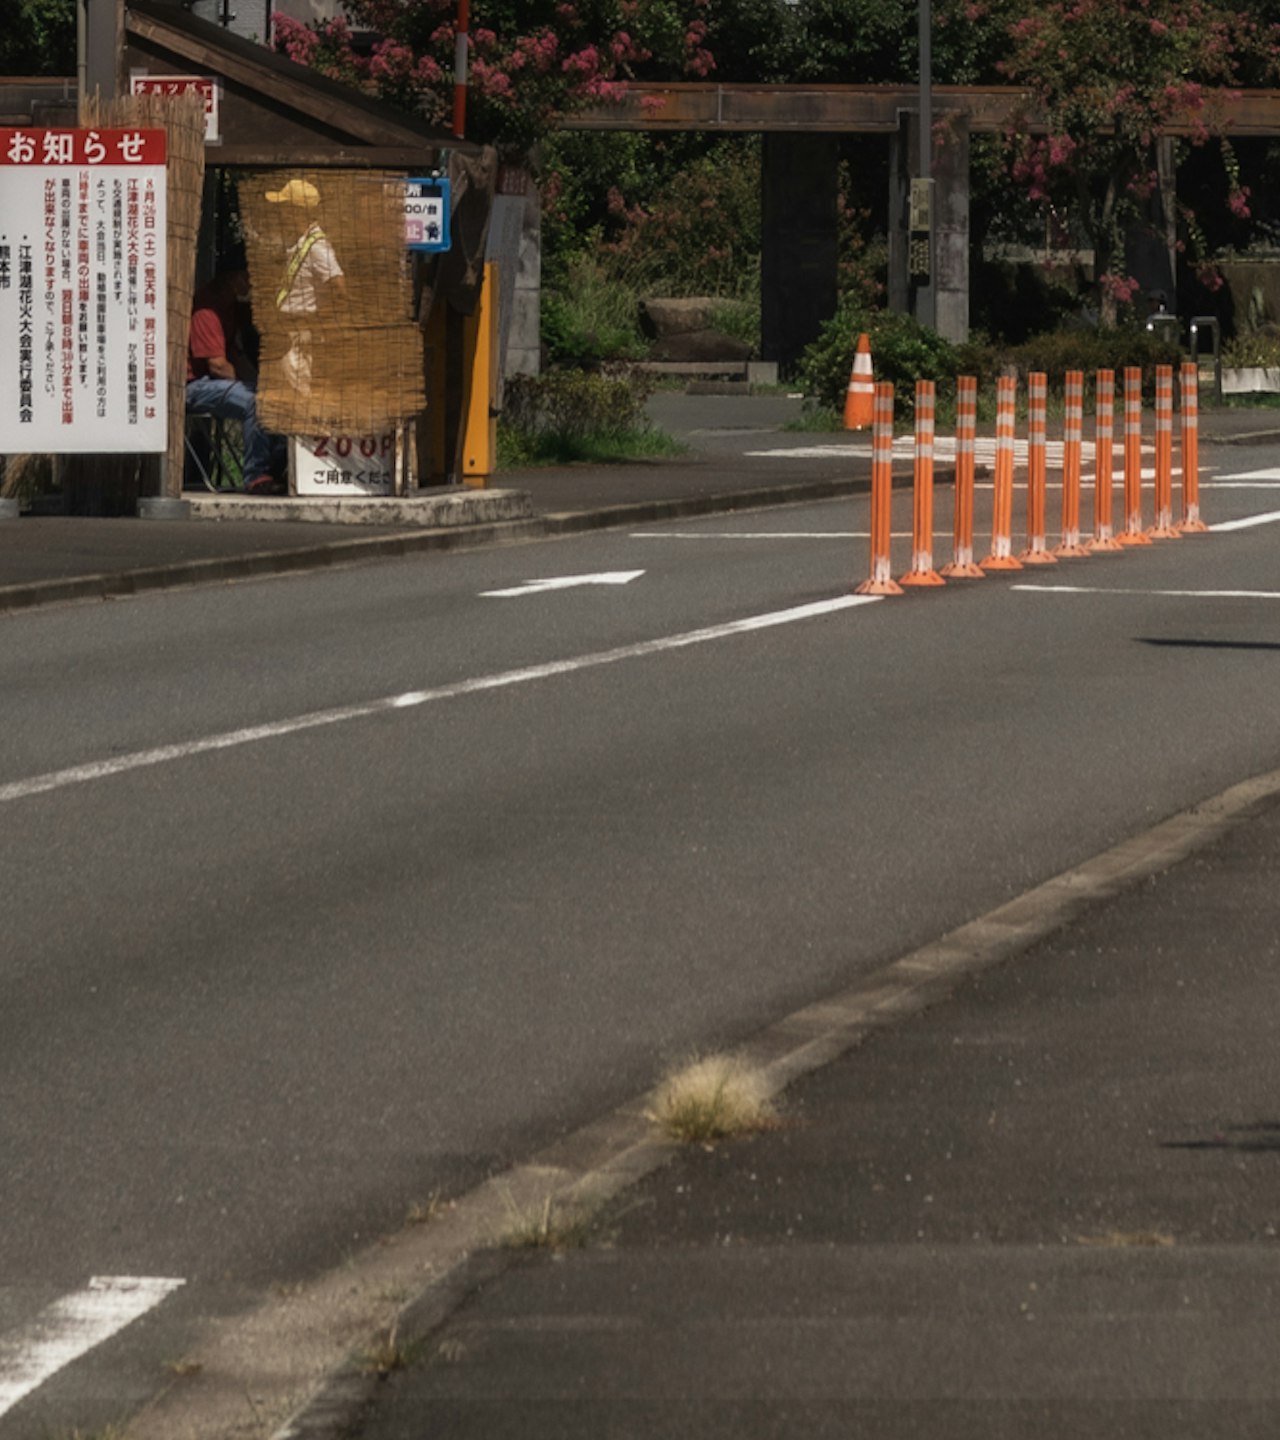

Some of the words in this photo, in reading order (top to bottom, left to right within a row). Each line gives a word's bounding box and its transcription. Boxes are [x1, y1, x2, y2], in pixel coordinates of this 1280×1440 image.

[7, 132, 145, 164] お知らせ
[313, 469, 391, 485] ご用意くださ
